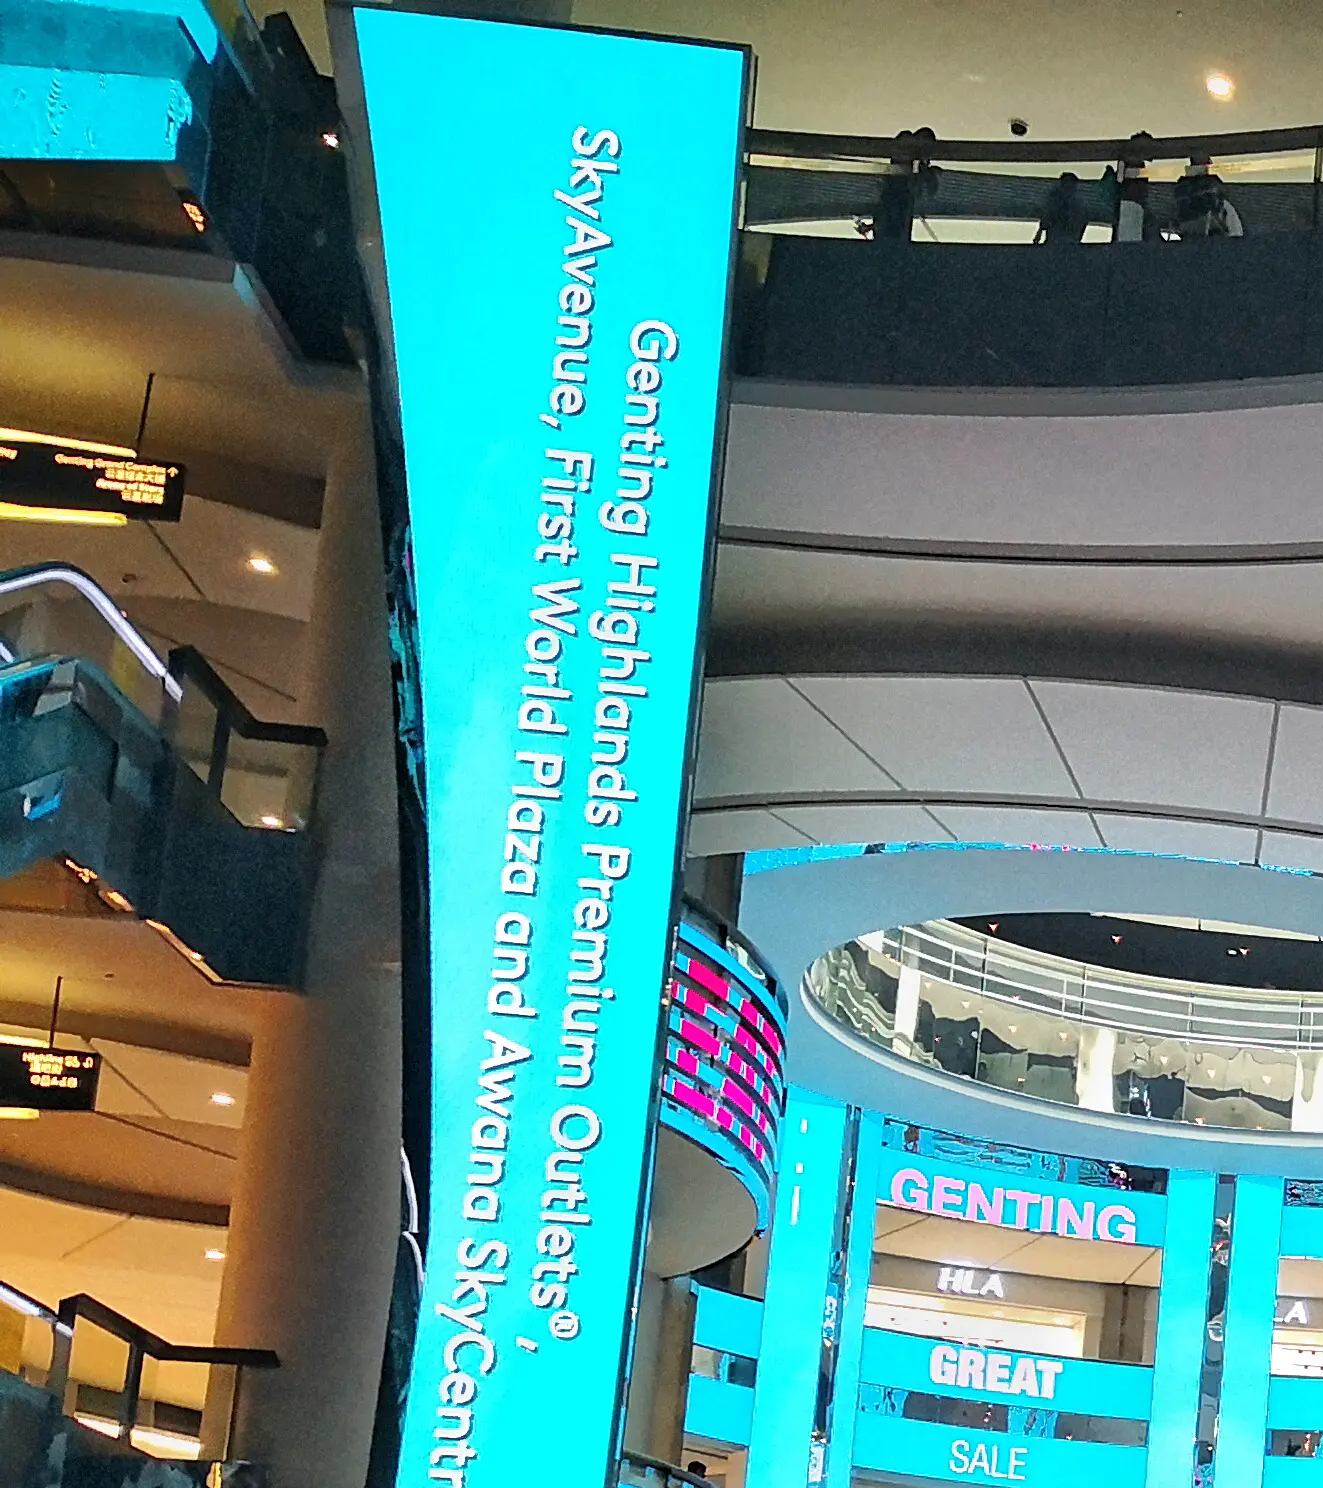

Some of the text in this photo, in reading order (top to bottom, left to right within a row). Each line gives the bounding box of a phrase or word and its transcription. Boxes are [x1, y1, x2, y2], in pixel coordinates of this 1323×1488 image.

[540, 127, 619, 428] SkyAvenue,
[600, 320, 678, 535] Genting
[536, 450, 593, 564] First
[518, 579, 581, 733] World
[585, 554, 659, 827] Highlands
[501, 752, 564, 894] Plaza
[488, 912, 538, 1017] and
[556, 844, 632, 1087] Premium
[462, 1030, 532, 1221] Awana
[891, 1168, 1137, 1244] GENTING
[936, 1267, 1004, 1298] HLA
[929, 1345, 1063, 1399] GREAT
[948, 1439, 1027, 1481] SALE
